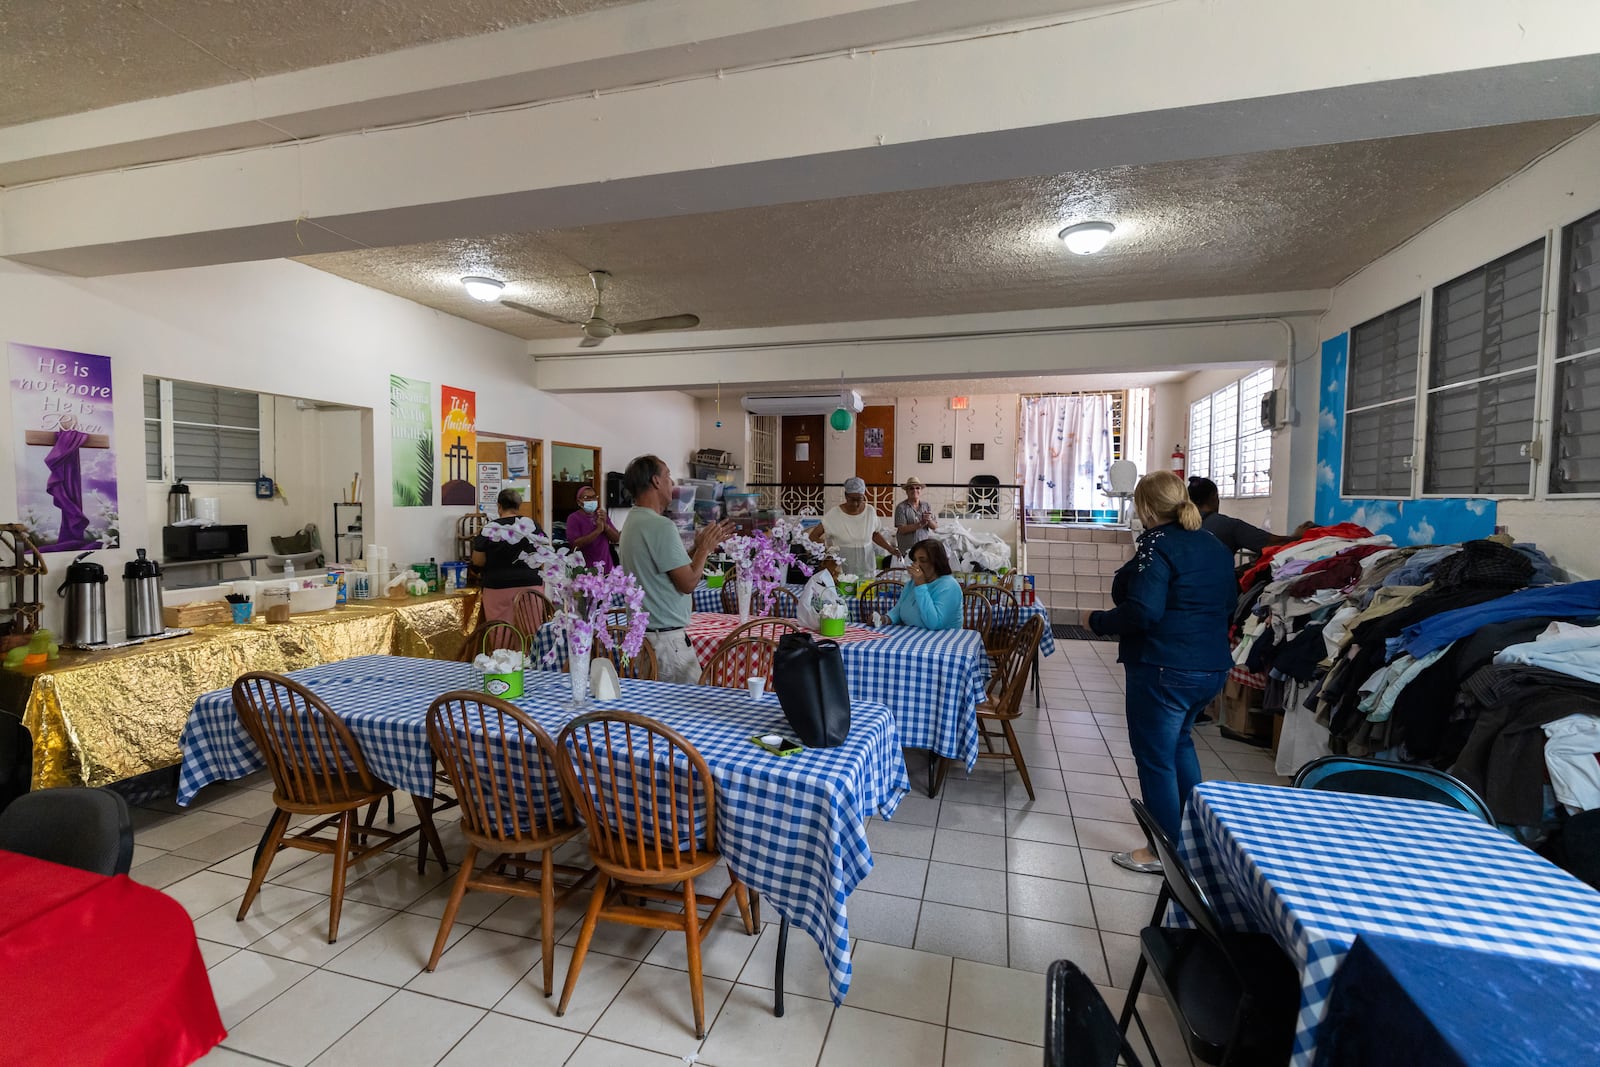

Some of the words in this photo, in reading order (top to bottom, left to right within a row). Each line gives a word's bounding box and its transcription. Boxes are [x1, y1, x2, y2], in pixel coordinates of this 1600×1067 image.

[38, 357, 67, 375] He
[73, 361, 89, 378] is
[19, 378, 58, 393] not
[43, 396, 73, 413] He
[79, 399, 95, 415] is
[461, 399, 469, 413] is
[41, 413, 104, 433] Risen
[441, 413, 477, 434] finished
